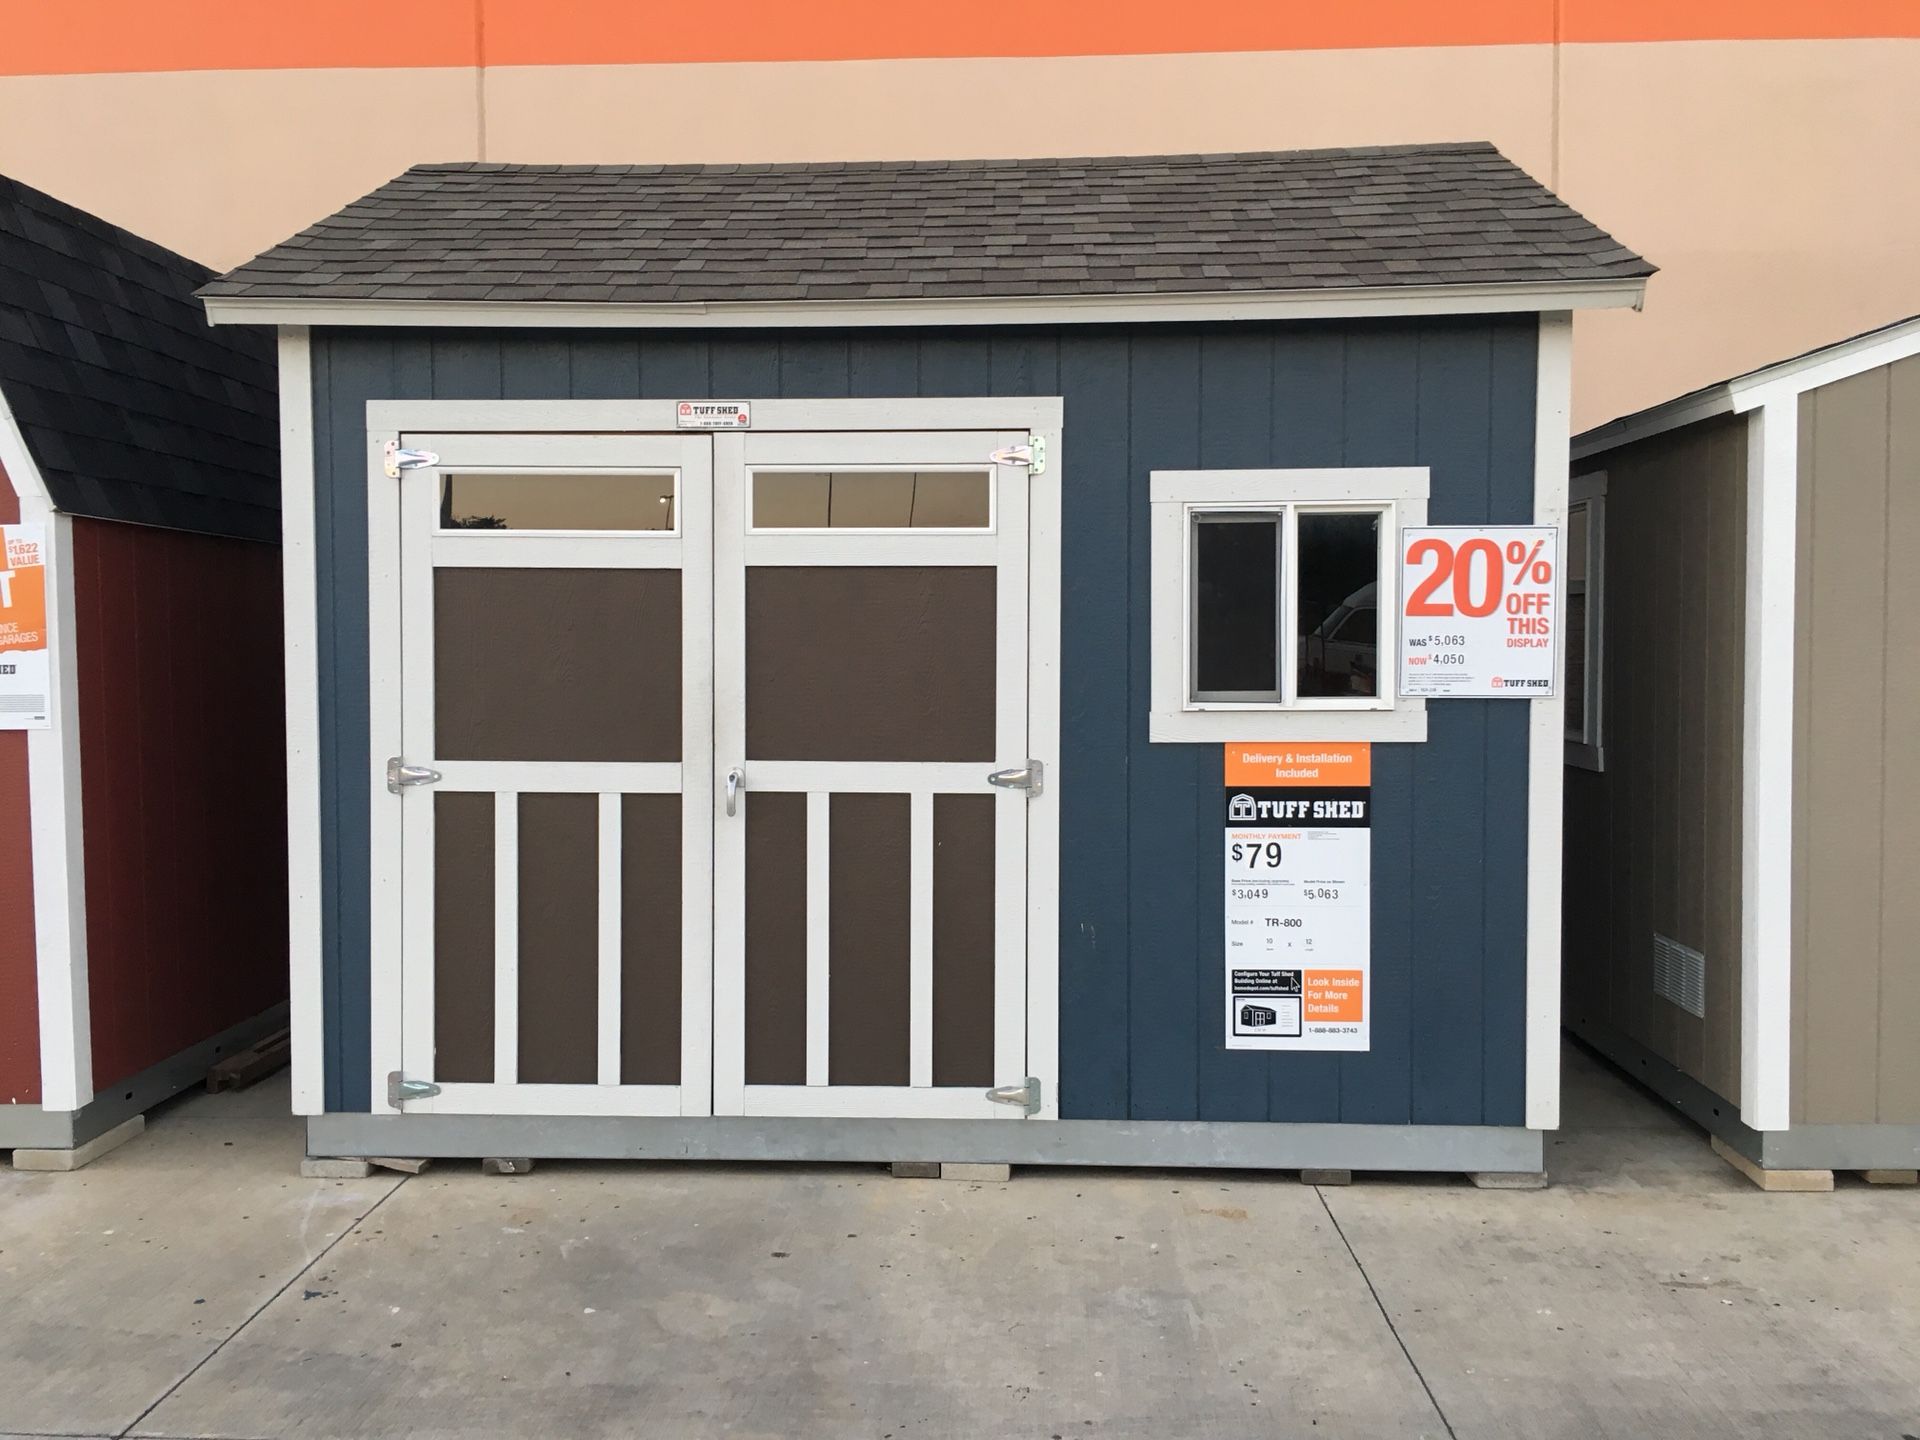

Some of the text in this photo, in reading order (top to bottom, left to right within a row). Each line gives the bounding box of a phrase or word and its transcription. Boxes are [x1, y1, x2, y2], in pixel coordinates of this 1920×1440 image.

[693, 406, 738, 414] TUFF SHED
[10, 554, 40, 566] VALUE
[1405, 538, 1552, 618] 20%
[1506, 593, 1550, 615] OFF
[1506, 617, 1550, 635] THIS
[1506, 638, 1549, 648] DISPLAY
[1408, 657, 1427, 666] NOW
[1503, 679, 1549, 688] TUFF SHED
[1242, 753, 1352, 765] Delivery & Installation
[1275, 768, 1319, 778] Included
[1257, 801, 1364, 819] TUFF SHED
[1231, 842, 1282, 869] $79
[1265, 918, 1302, 928] TR-800
[1307, 977, 1360, 987] Look Inside
[1307, 991, 1348, 1000] For More
[1307, 1003, 1339, 1013] Details
